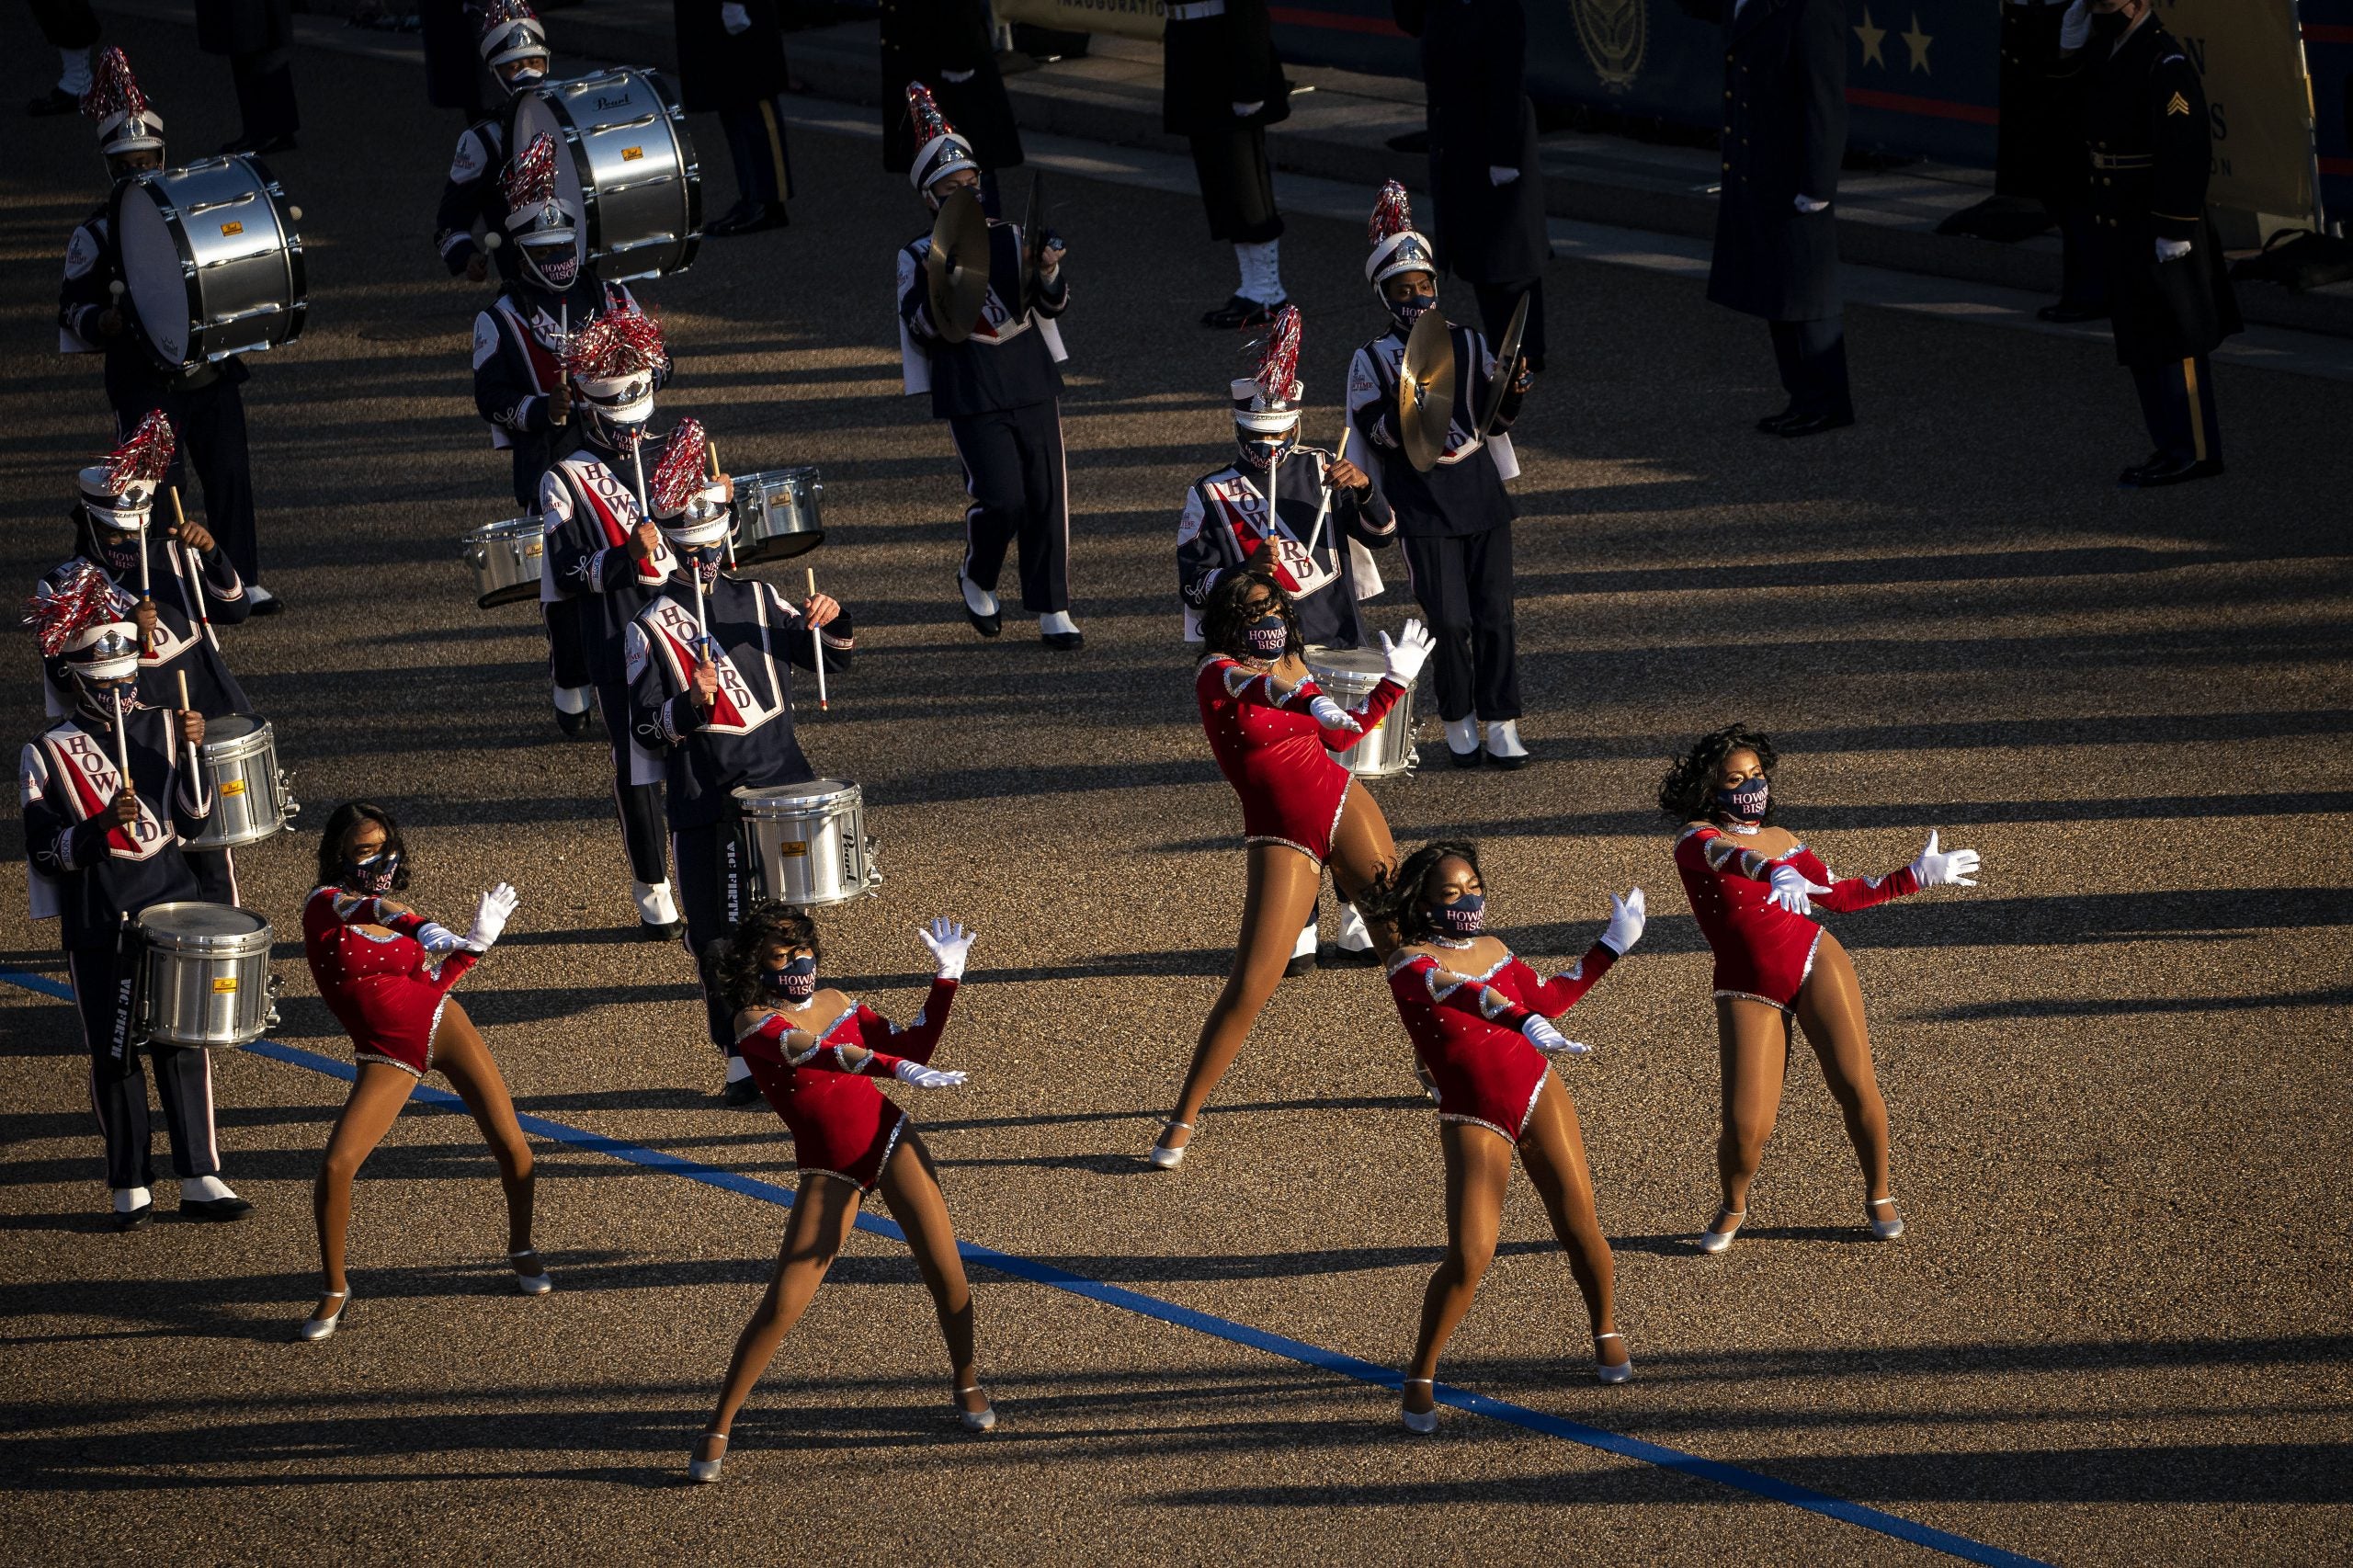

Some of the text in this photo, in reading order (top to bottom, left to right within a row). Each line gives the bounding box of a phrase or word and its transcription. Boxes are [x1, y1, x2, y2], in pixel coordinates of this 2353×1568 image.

[1743, 800, 1766, 814] BISO
[843, 827, 857, 881] Pearl
[1456, 919, 1483, 932] BISO
[788, 982, 815, 995] BISO
